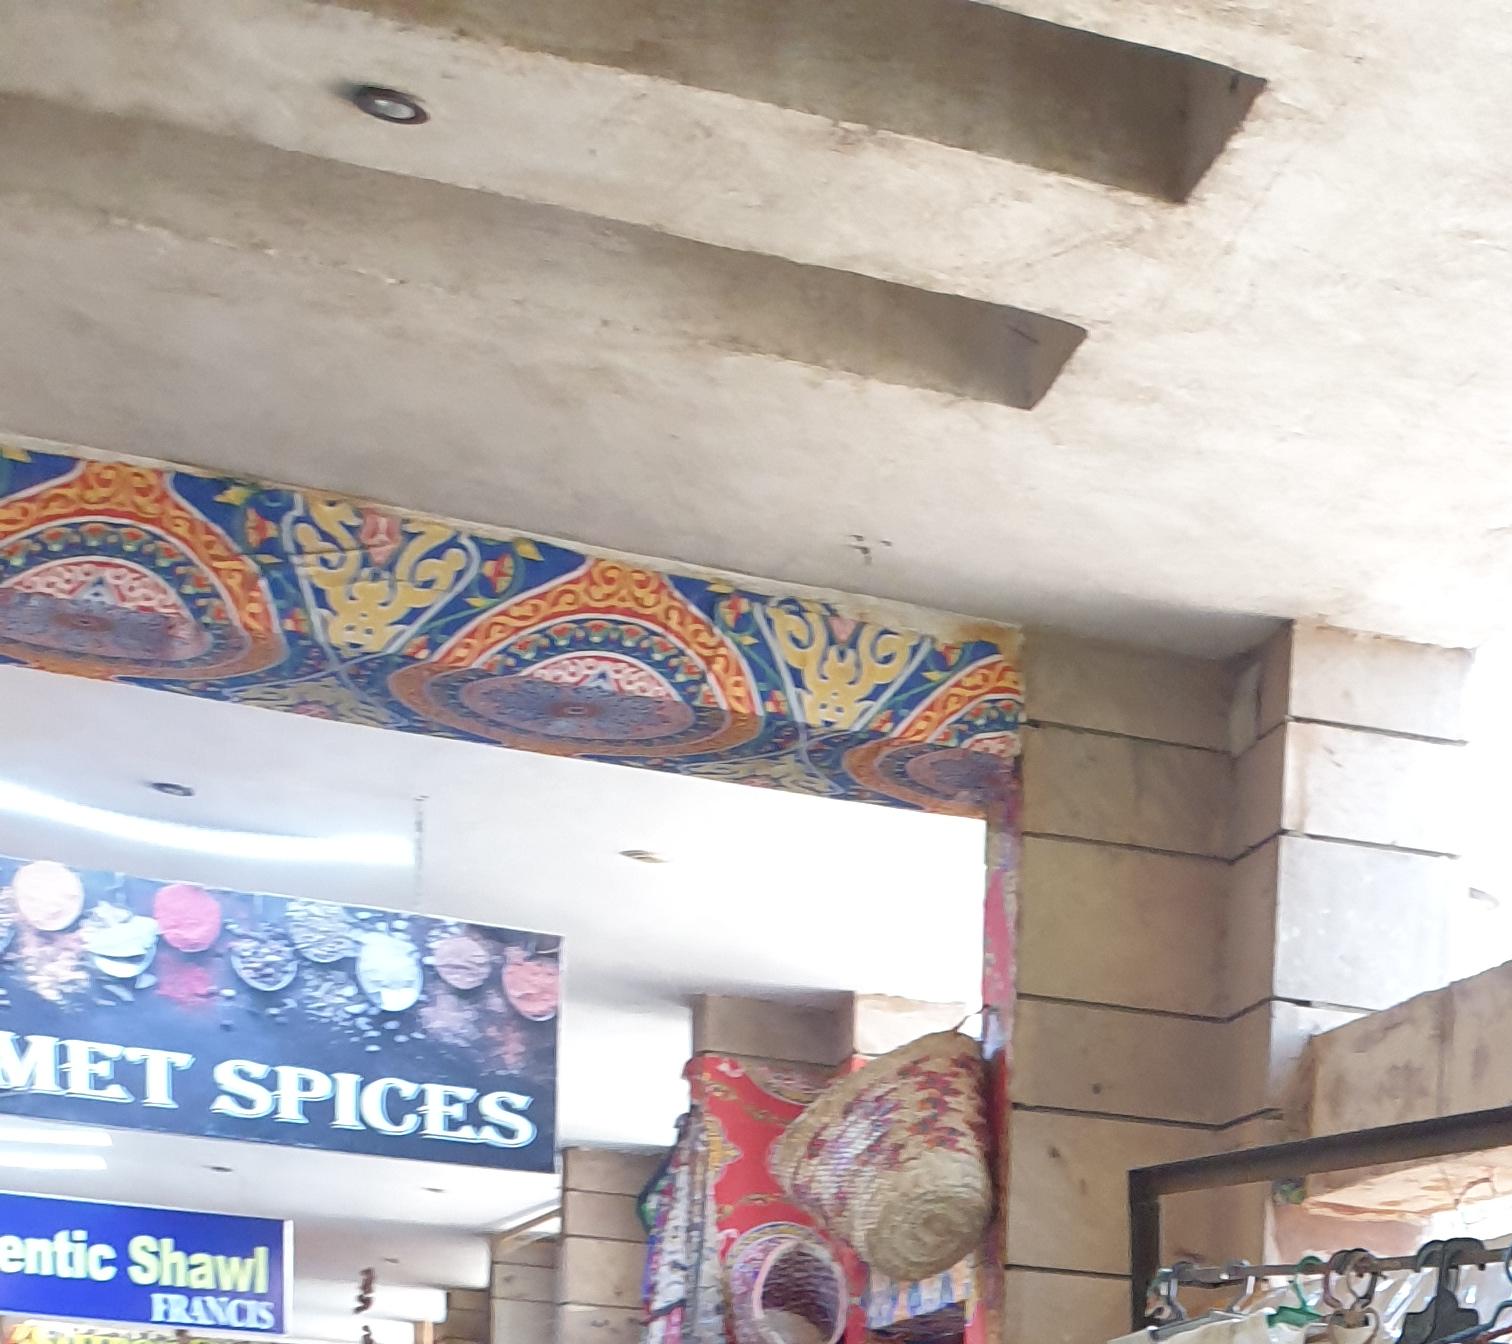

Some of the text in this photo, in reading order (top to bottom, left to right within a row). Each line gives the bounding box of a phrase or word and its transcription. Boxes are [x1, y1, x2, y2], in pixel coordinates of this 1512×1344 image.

[209, 1058, 537, 1148] SPICES
[127, 1235, 269, 1293] Shawl
[150, 1293, 275, 1329] FRANCIS
